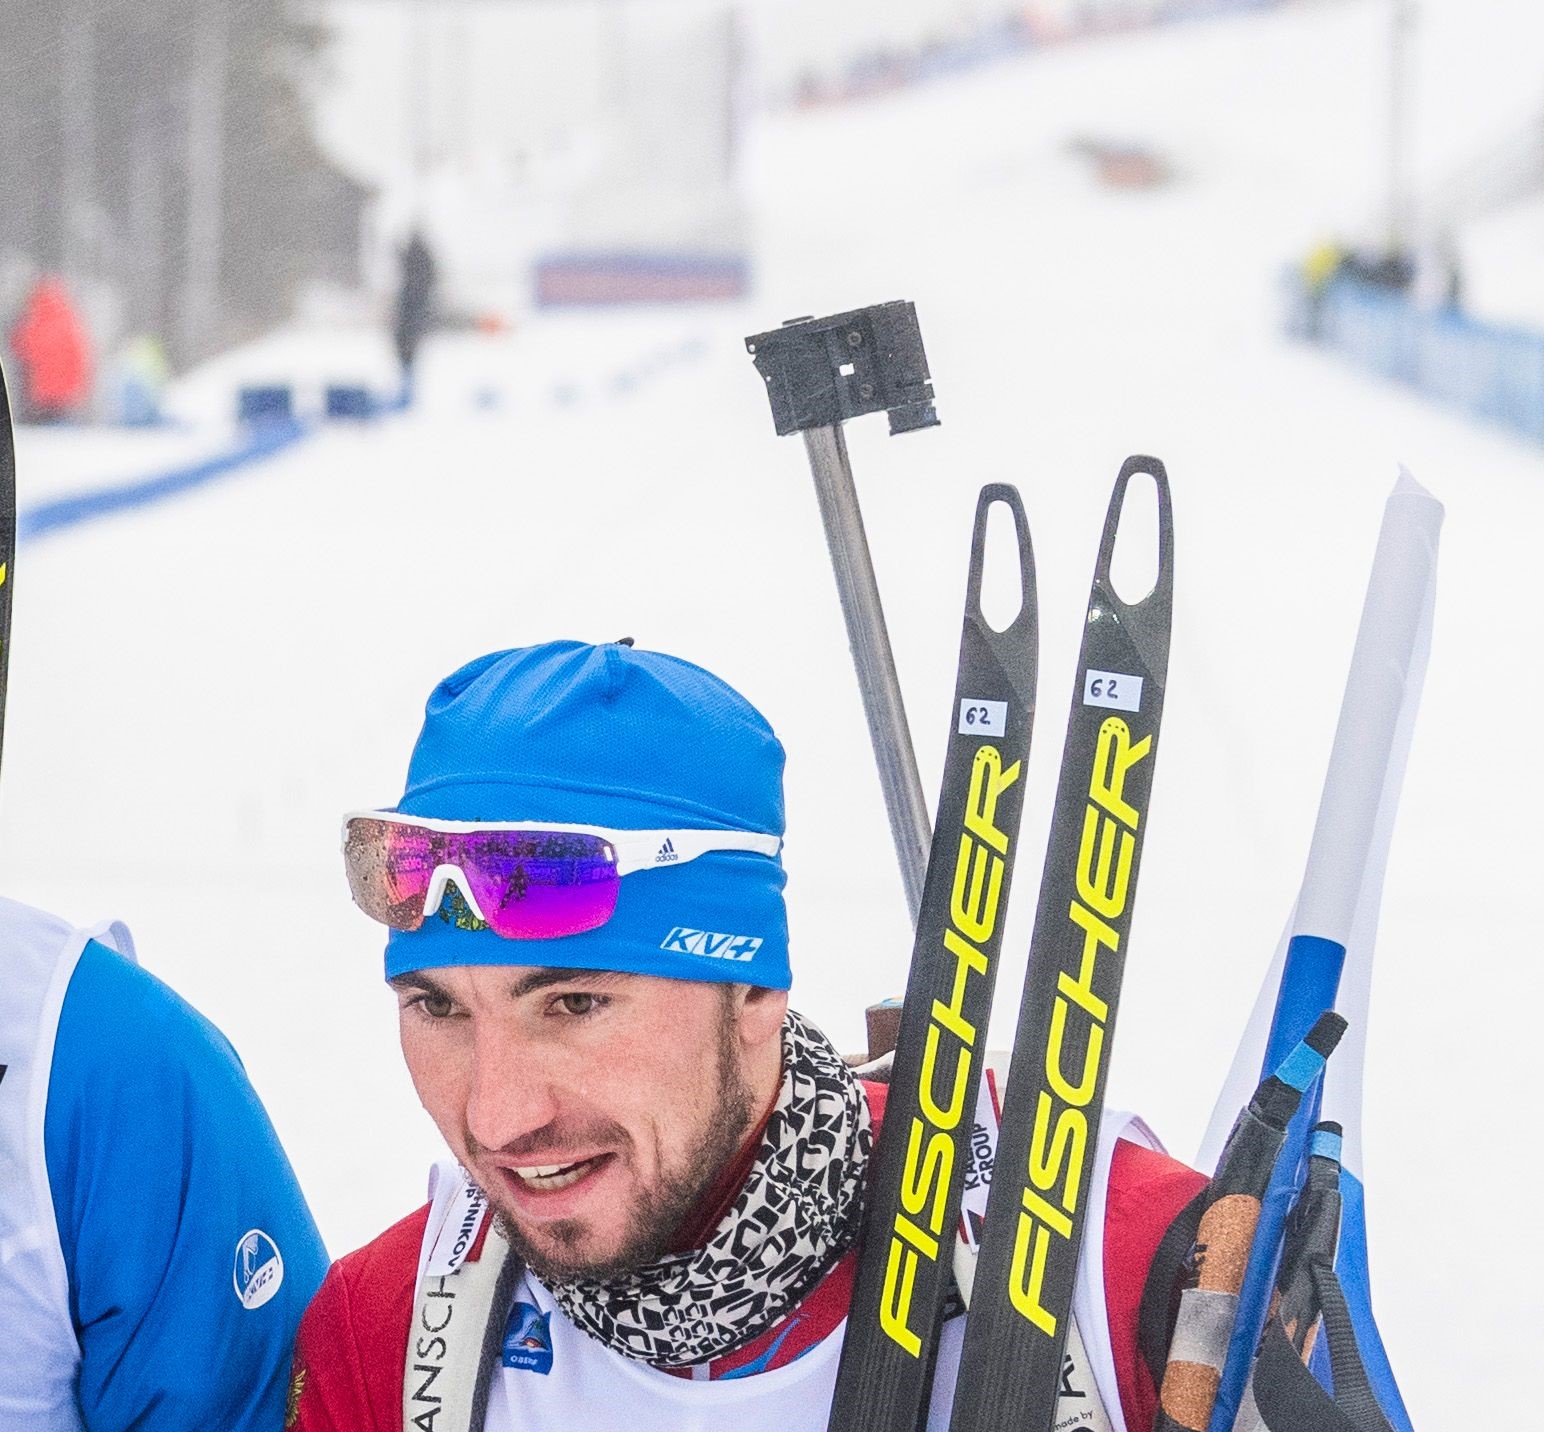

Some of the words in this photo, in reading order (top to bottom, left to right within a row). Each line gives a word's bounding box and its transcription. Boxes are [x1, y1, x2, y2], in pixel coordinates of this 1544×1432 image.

[1090, 677, 1119, 701] 62
[964, 705, 992, 727] 62
[655, 852, 680, 864] adidas
[1008, 716, 1152, 1338] FISCHER
[879, 745, 1021, 1358] FISCHER
[1080, 1409, 1094, 1425] by
